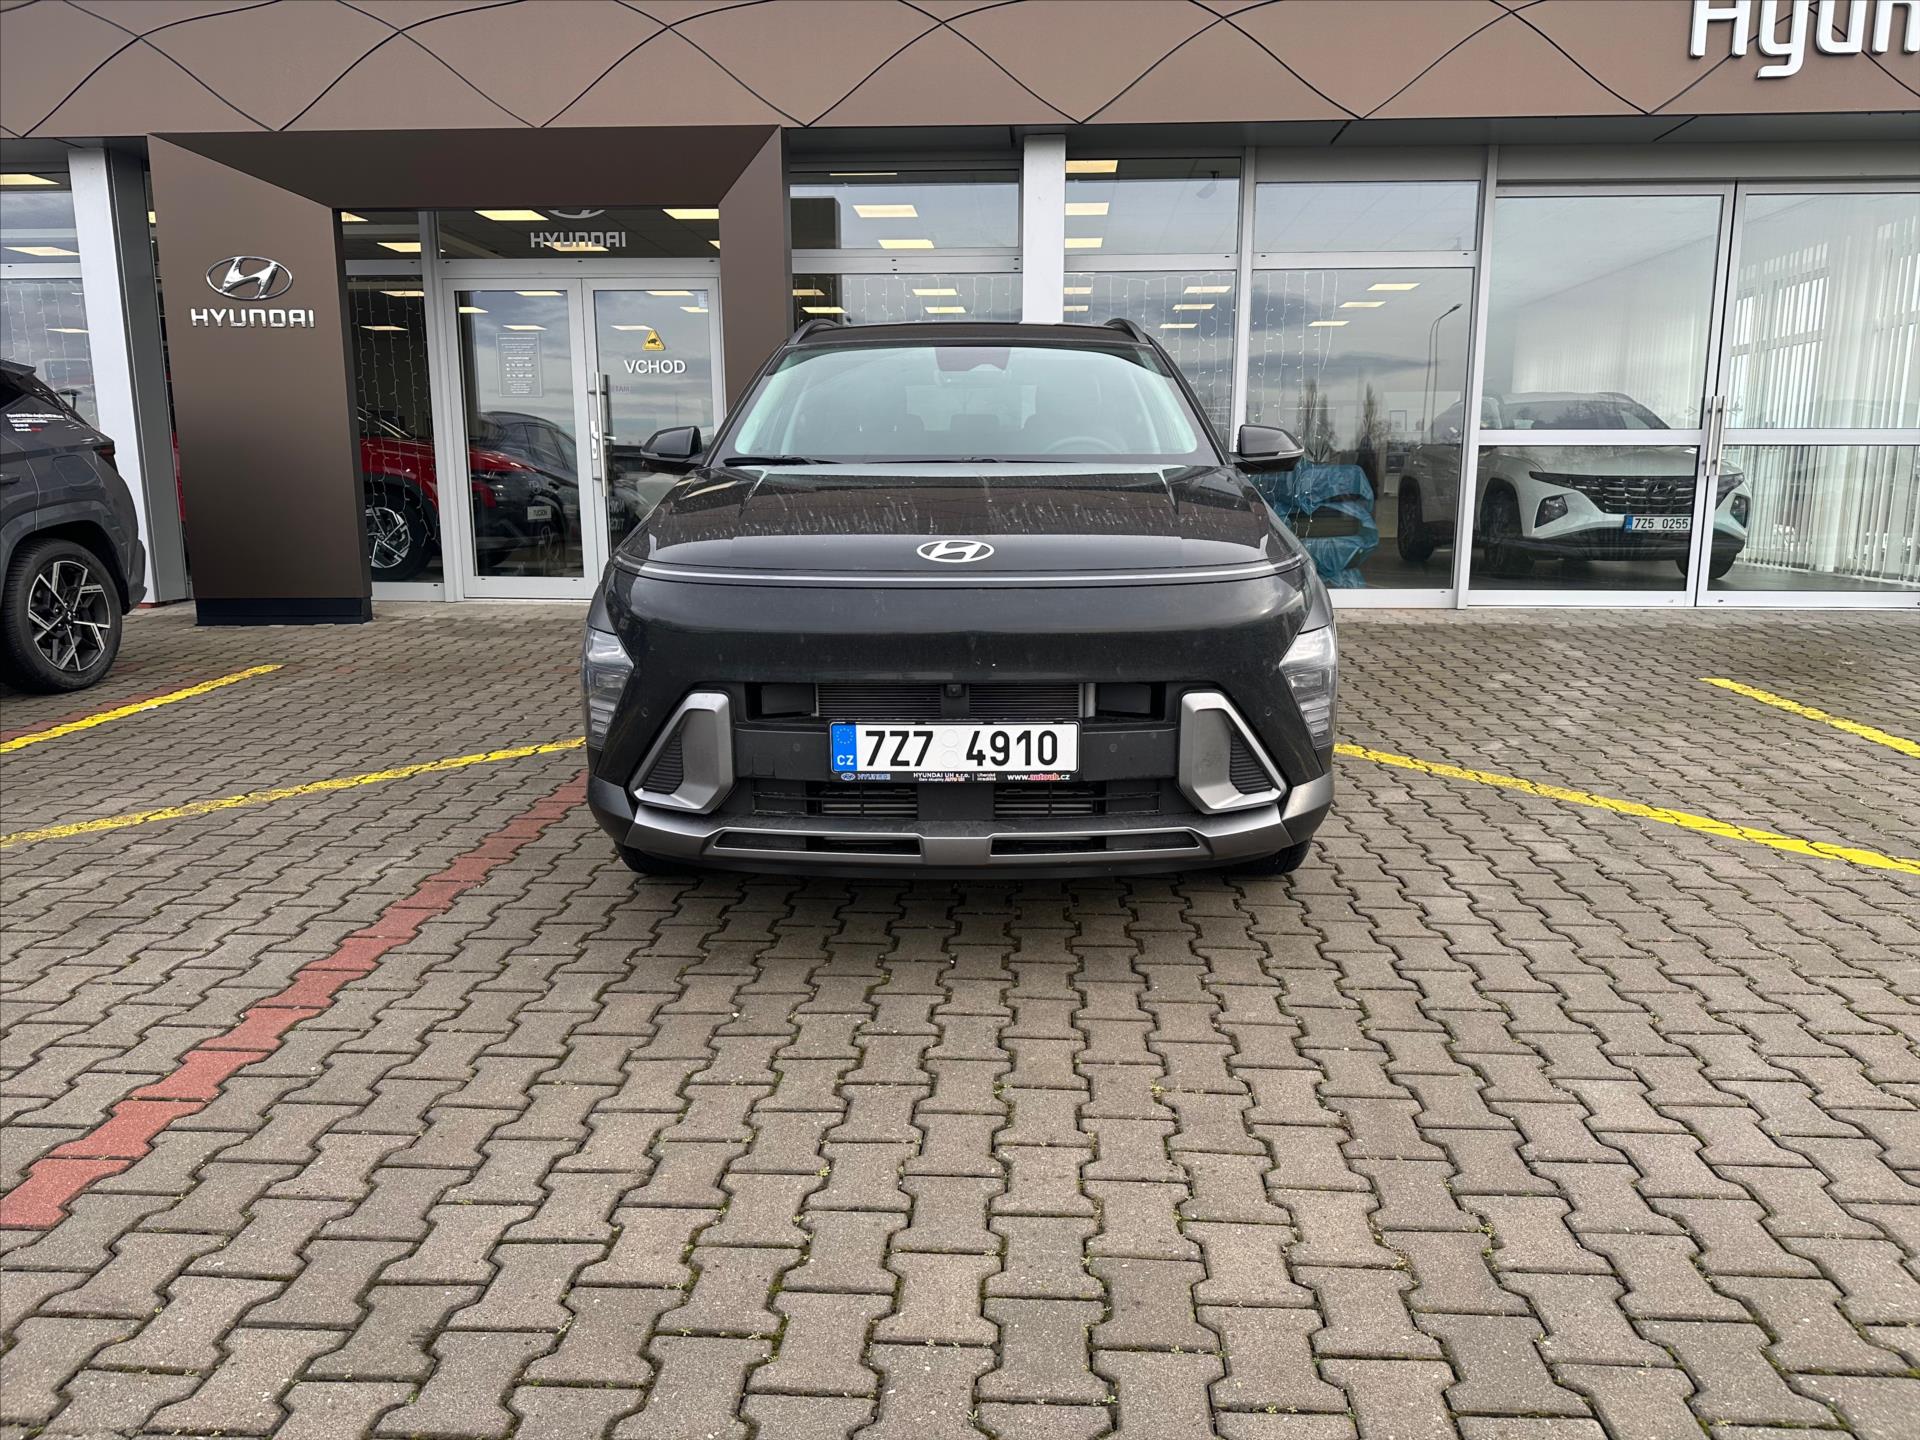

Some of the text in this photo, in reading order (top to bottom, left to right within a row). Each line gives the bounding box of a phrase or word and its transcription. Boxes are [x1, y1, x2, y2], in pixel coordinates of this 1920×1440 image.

[530, 231, 626, 248] HYUNDAI
[190, 308, 315, 328] HYUNDAI
[624, 359, 686, 374] VCHOD
[1634, 518, 1688, 529] 7Z5 0255
[865, 730, 1058, 767] 7Z7 4910
[837, 755, 854, 766] CZ
